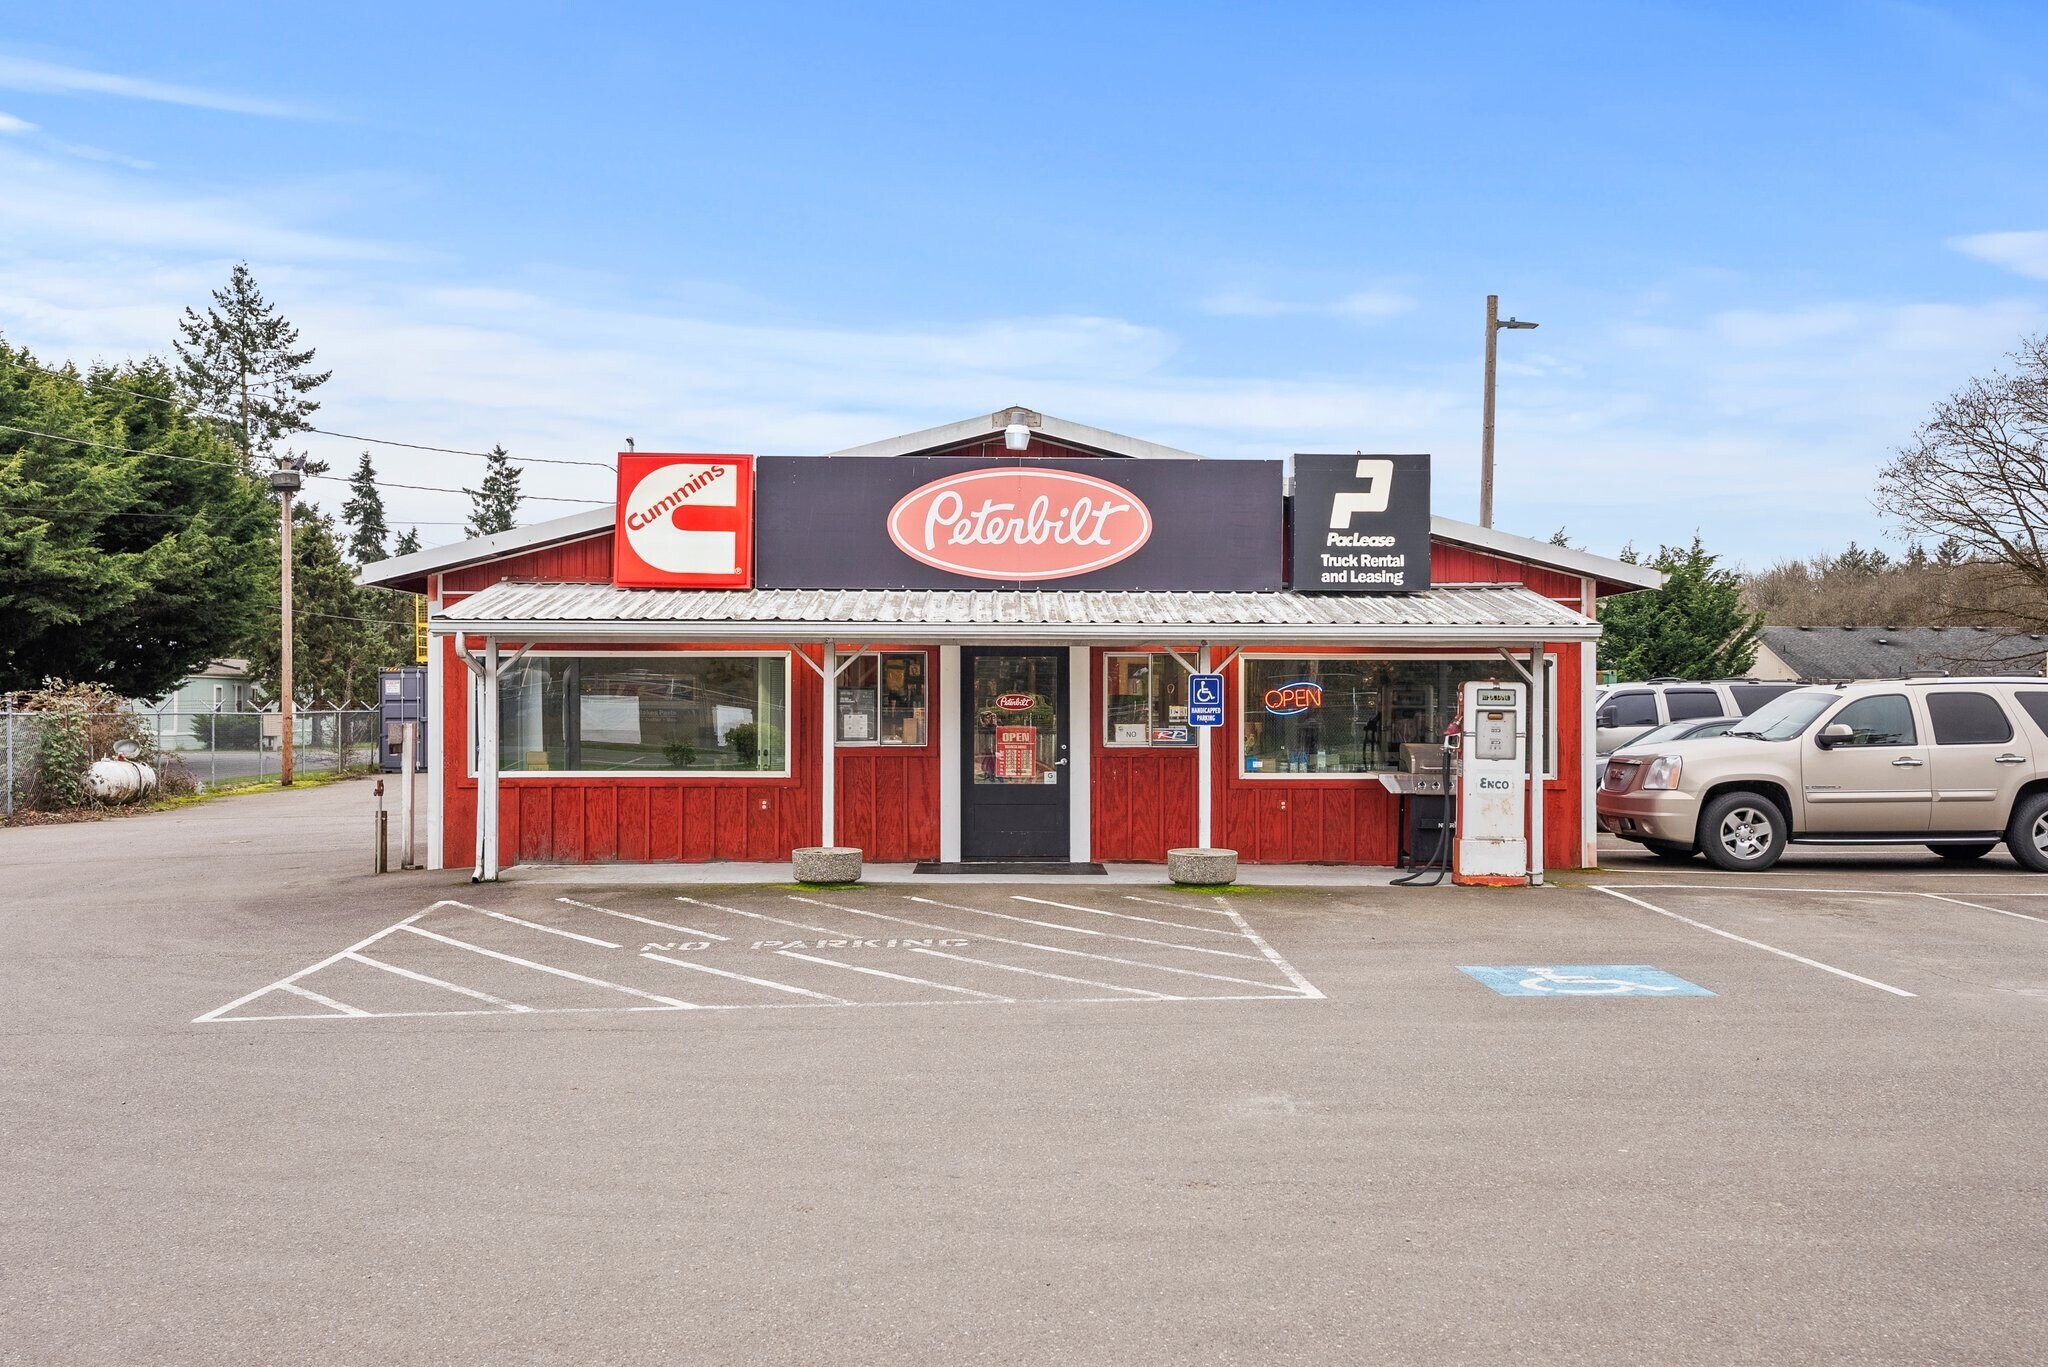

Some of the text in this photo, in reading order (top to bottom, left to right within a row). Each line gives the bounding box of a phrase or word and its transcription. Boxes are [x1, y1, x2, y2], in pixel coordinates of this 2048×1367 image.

[627, 464, 726, 532] Cummins
[924, 491, 1130, 553] Peterbilt
[1326, 532, 1396, 547] PacLease
[1320, 553, 1405, 568] Truck Rental
[1321, 569, 1404, 585] and Leasing
[1000, 697, 1031, 707] Peterbilt
[1265, 689, 1321, 709] OPEN
[1002, 732, 1030, 742] OPEN
[1479, 777, 1510, 790] ENCO
[640, 939, 970, 951] NO PARKING
